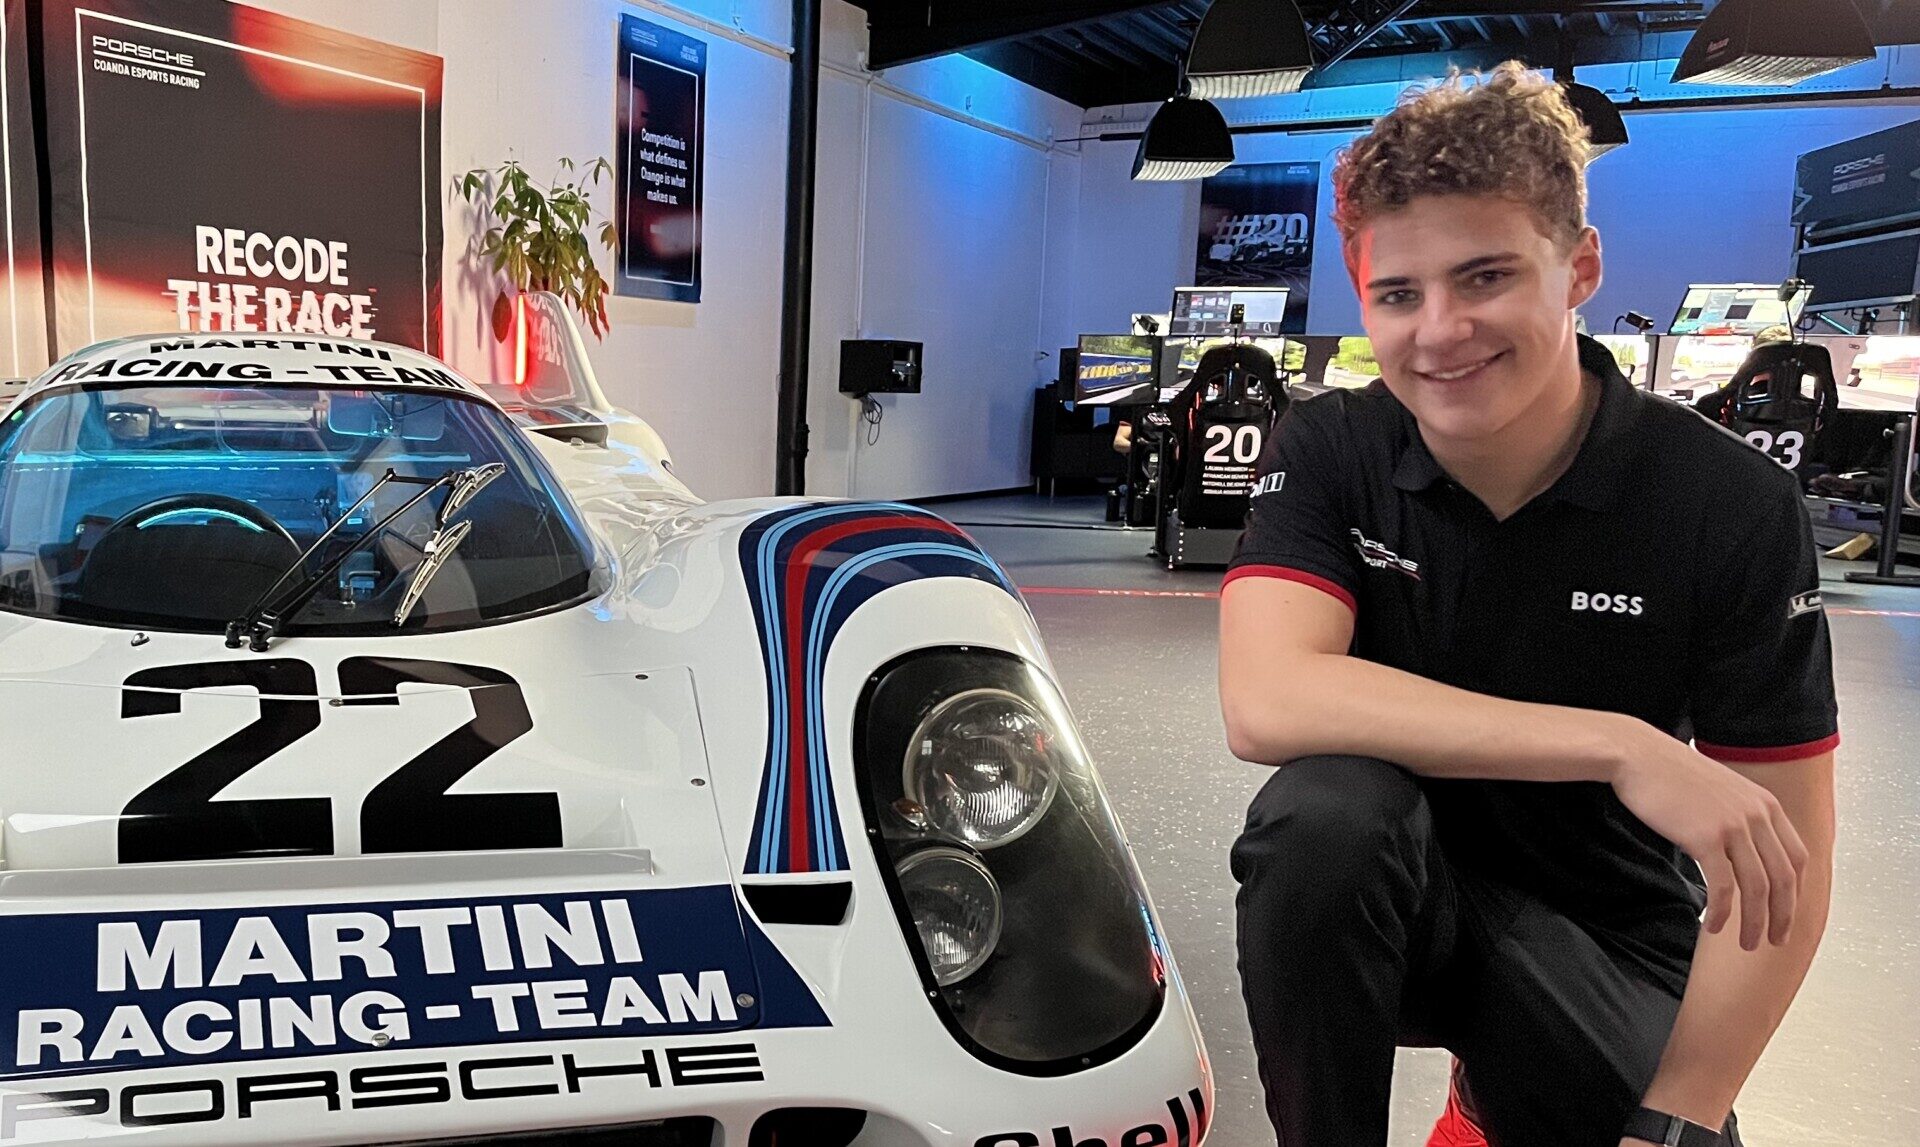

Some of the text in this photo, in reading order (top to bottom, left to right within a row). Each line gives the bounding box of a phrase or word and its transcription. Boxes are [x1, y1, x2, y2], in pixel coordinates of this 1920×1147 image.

[92, 35, 194, 68] PORSCHE
[93, 58, 200, 89] COANDA ESPORTS RACING
[641, 127, 680, 149] Competition
[640, 148, 655, 163] what
[655, 150, 678, 168] defines
[641, 166, 686, 188] Change is what
[646, 189, 669, 203] makes
[196, 225, 349, 286] RECODE
[163, 279, 377, 340] THE RACE
[150, 339, 392, 362] MARTINI
[46, 359, 272, 387] RACING
[314, 365, 466, 390] TEAM
[1204, 425, 1262, 464] 20
[1744, 430, 1804, 470] 23
[1571, 591, 1644, 616] BOSS
[118, 655, 563, 864] 22
[97, 898, 643, 991] MARTINI
[16, 990, 411, 1066] RACING
[471, 970, 739, 1033] TEAM
[1, 1042, 765, 1140] PORSCHE
[973, 1087, 1208, 1147] ell
